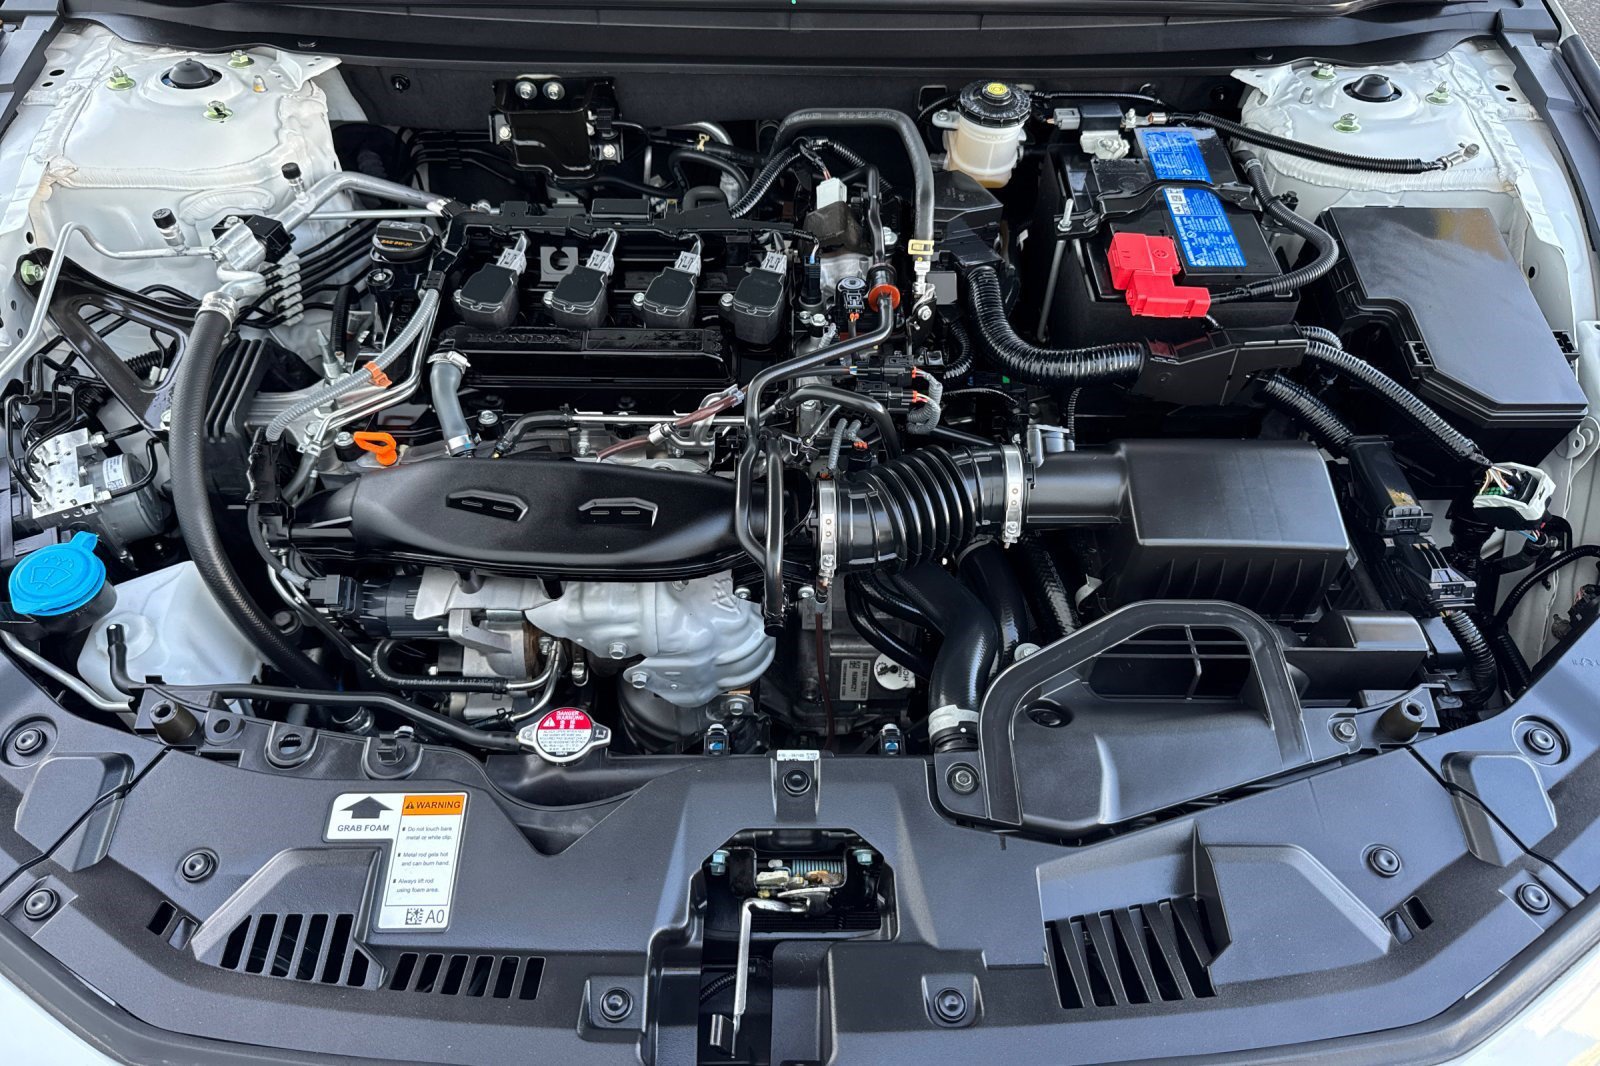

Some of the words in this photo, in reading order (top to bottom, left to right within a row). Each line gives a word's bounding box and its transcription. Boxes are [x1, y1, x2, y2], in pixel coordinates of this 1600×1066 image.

[467, 332, 569, 344] HONDA
[416, 801, 461, 809] WARNING
[337, 824, 362, 832] GRAB
[364, 824, 390, 832] FOAM
[425, 909, 445, 924] A0
